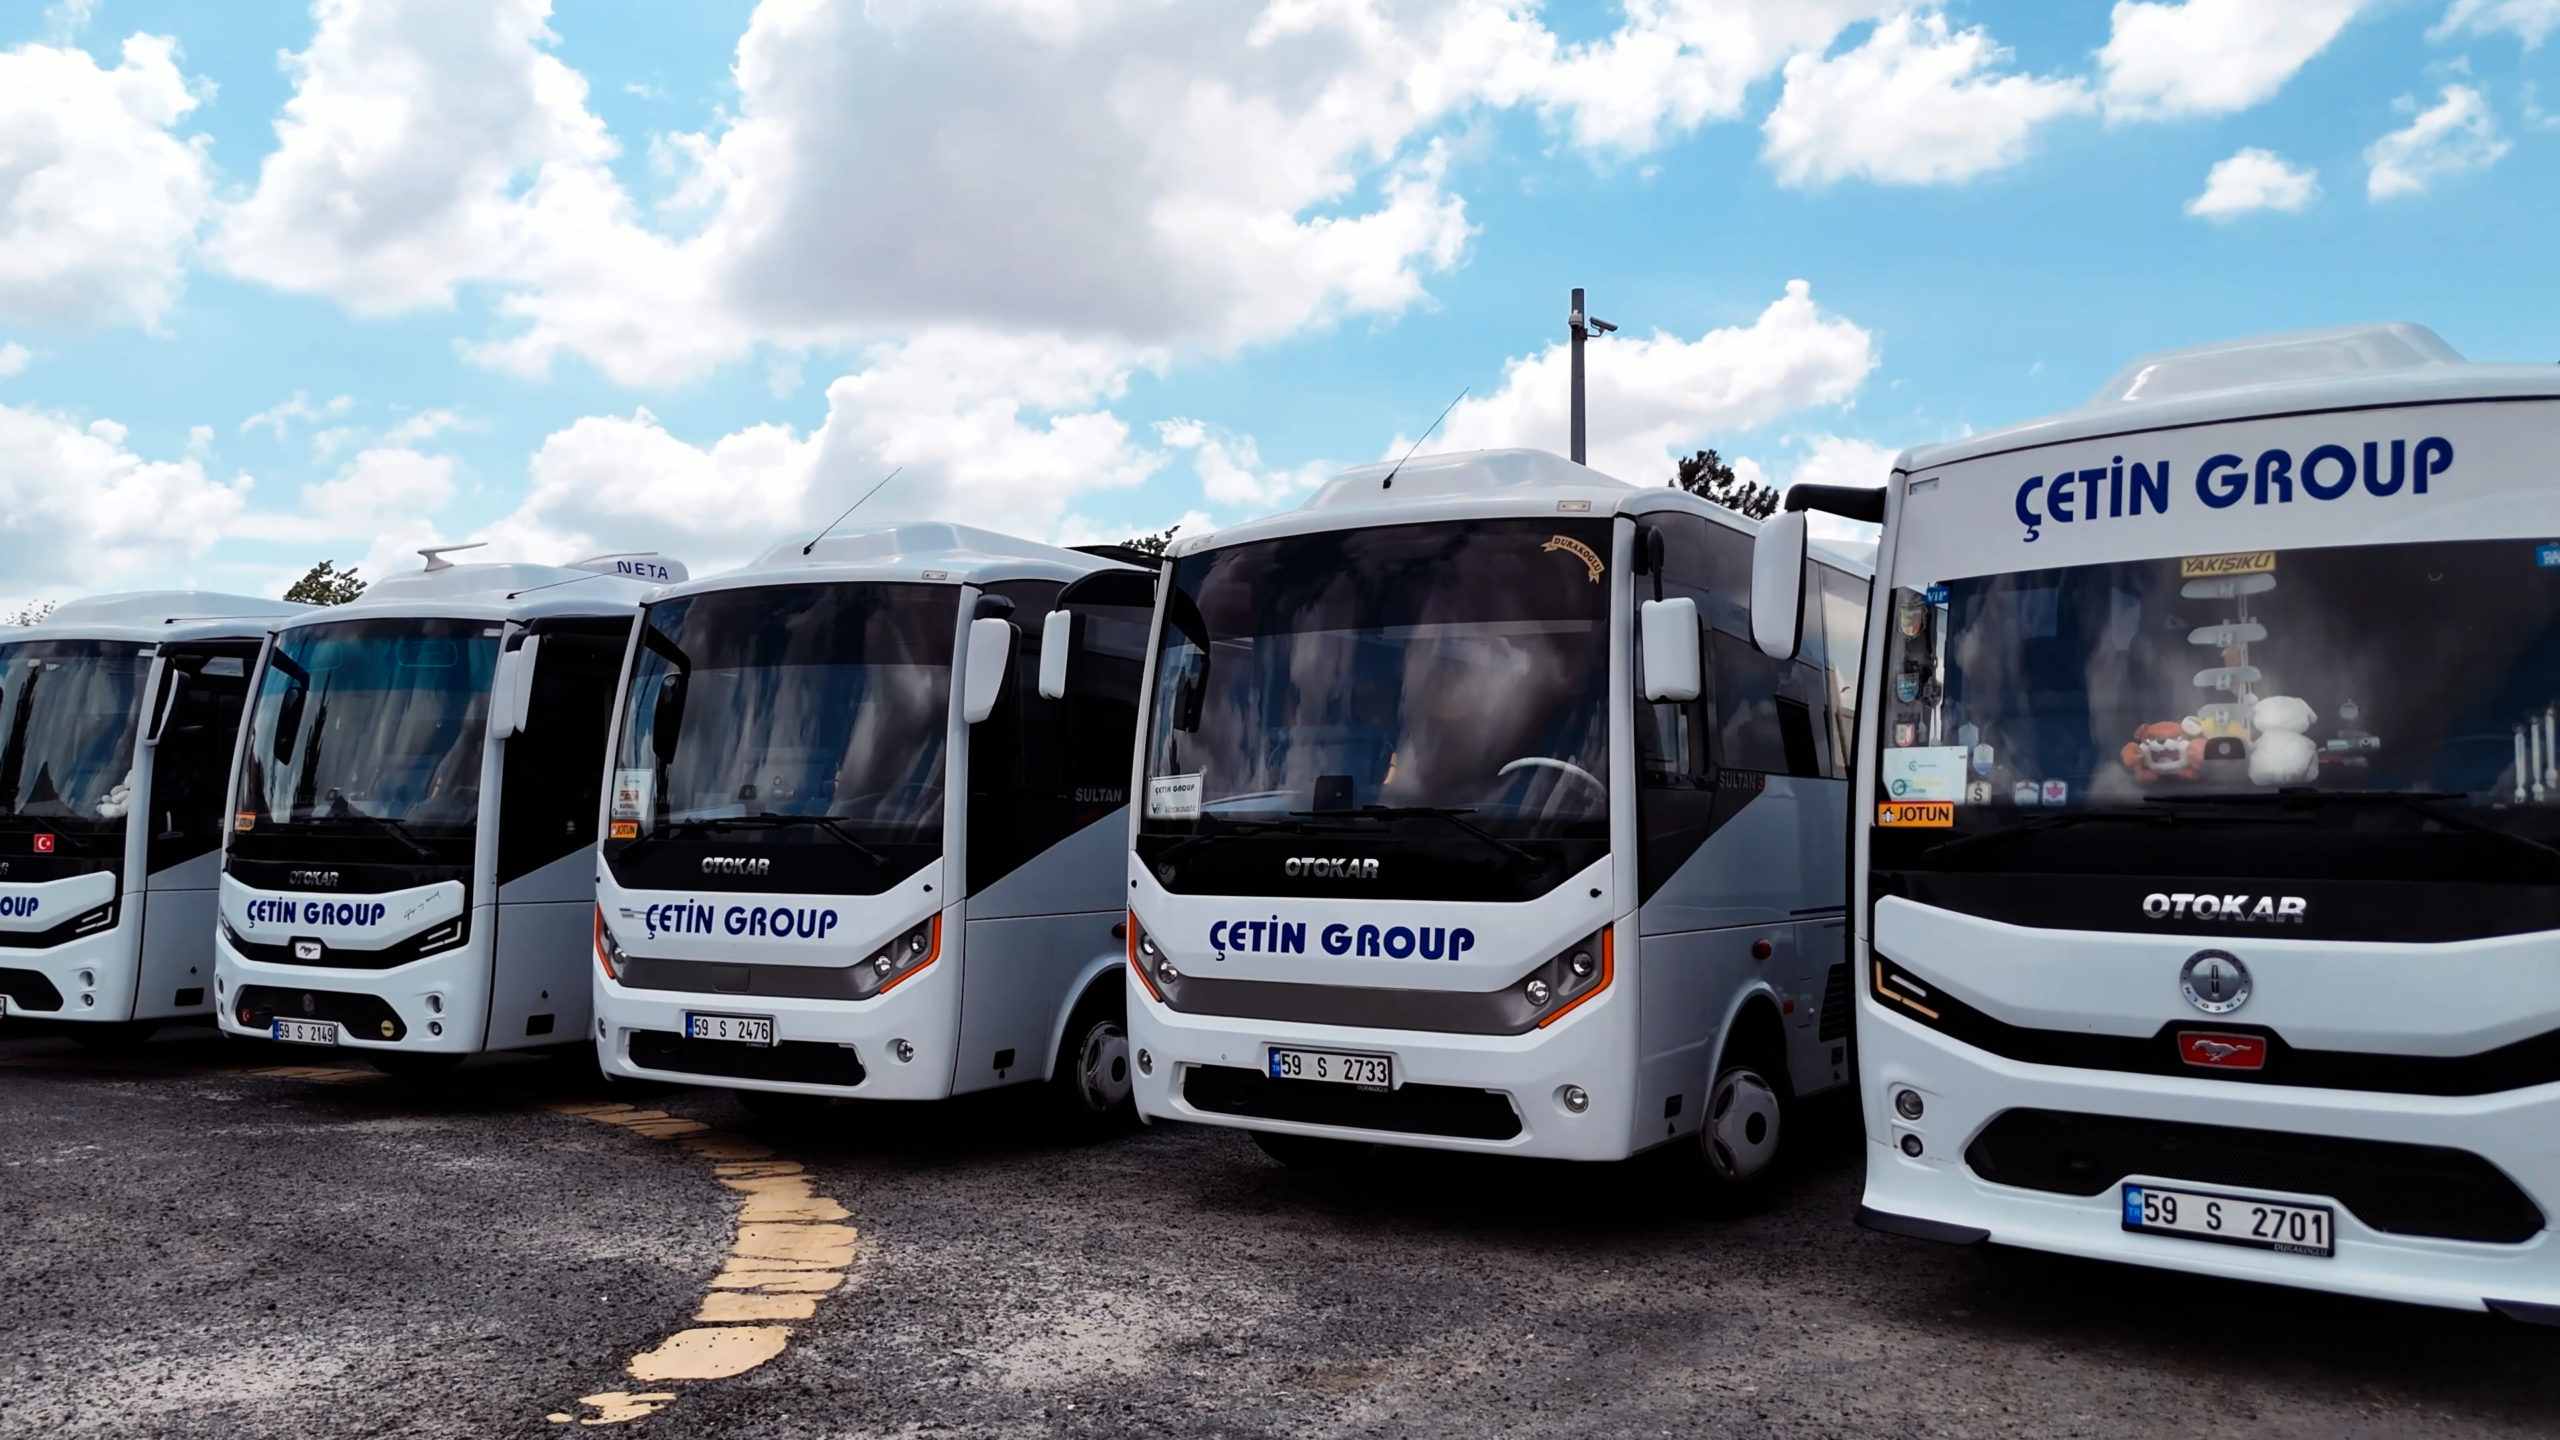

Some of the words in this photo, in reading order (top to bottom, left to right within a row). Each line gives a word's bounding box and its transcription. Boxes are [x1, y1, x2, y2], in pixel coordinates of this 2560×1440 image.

[2015, 455, 2169, 543] ÇETİN
[2195, 436, 2453, 509] GROUP
[1553, 537, 1602, 571] DURAKOĞLU
[617, 560, 668, 580] NETA
[1173, 784, 1195, 793] GROUP
[1719, 770, 1756, 790] SULTAN
[1075, 787, 1122, 802] SULTAN
[1897, 806, 1950, 822] JOTUN
[703, 857, 770, 875] OTOKAR
[1285, 857, 1380, 879] OTOKAR
[289, 871, 339, 886] OTOKAR
[0, 896, 39, 917] OUP
[247, 896, 297, 928] ÇETİN
[303, 902, 385, 926] GROUP
[2142, 893, 2307, 923] OTOKAR
[645, 898, 714, 940] ÇETİN
[724, 906, 838, 939] GROUP
[1209, 914, 1306, 961] ÇETİN
[1321, 923, 1475, 961] GROUP
[279, 1022, 290, 1039] 59
[297, 1026, 303, 1040] S
[311, 1026, 333, 1043] 2149
[694, 1018, 709, 1036] 59
[719, 1020, 727, 1038] S
[738, 1021, 769, 1040] 2476
[1281, 1053, 1301, 1076] 59
[1317, 1057, 1327, 1078] S
[1343, 1059, 1387, 1083] 2733
[2127, 1206, 2141, 1217] TR
[2143, 1192, 2177, 1225] 59
[2206, 1201, 2222, 1231] S
[2251, 1207, 2323, 1245] 2701
